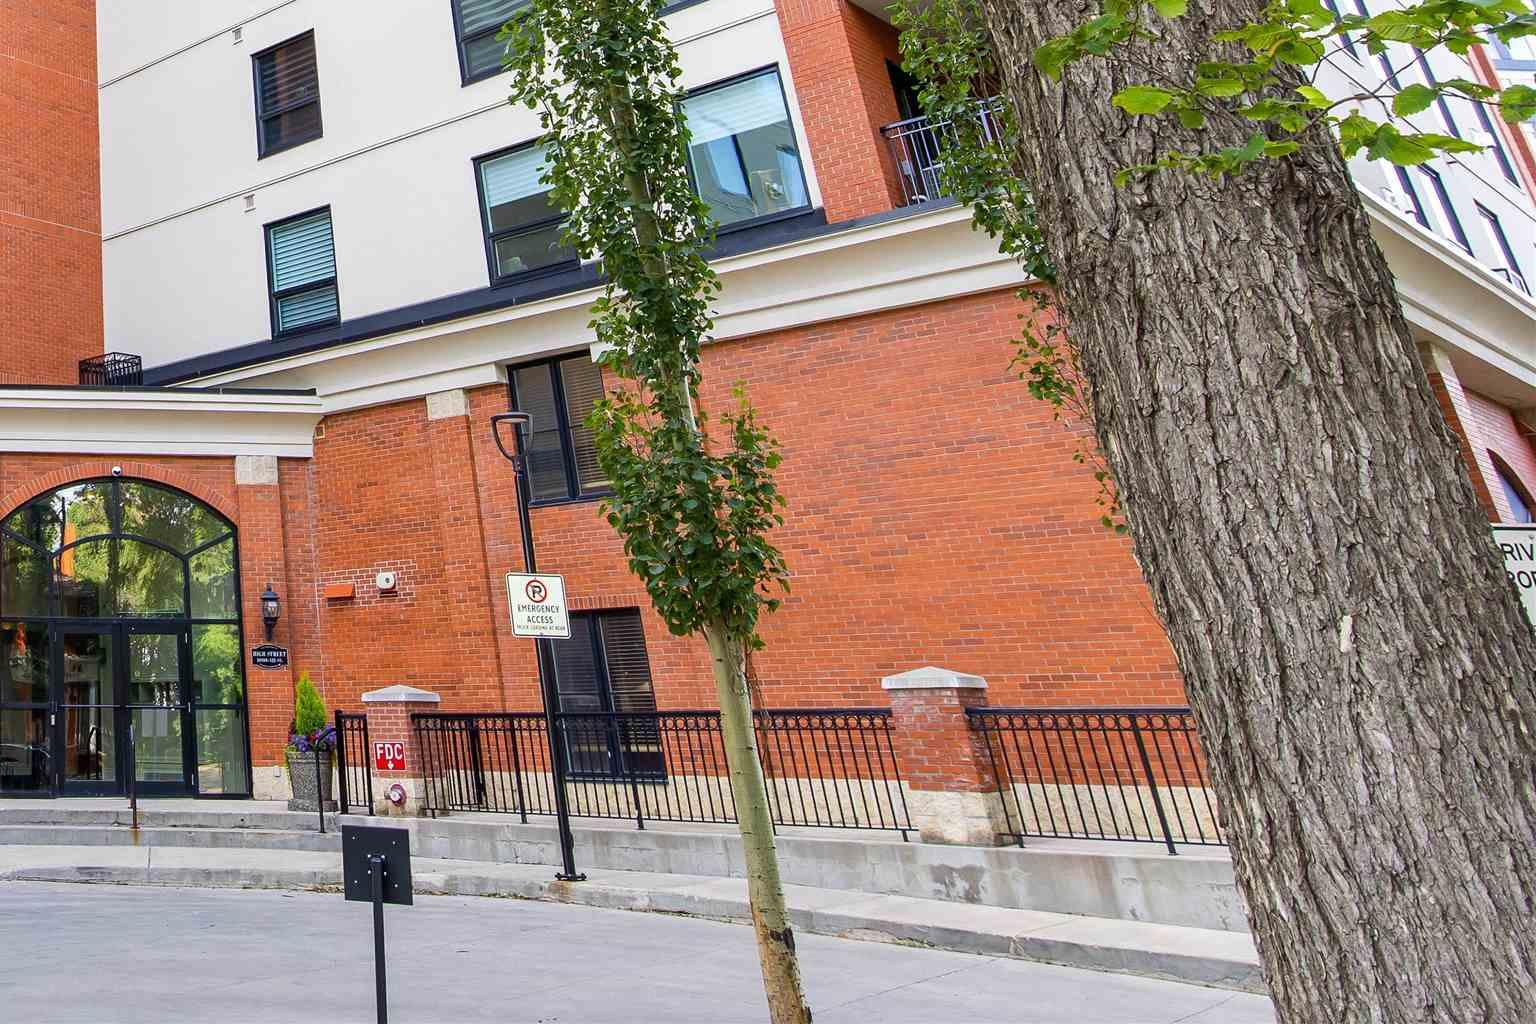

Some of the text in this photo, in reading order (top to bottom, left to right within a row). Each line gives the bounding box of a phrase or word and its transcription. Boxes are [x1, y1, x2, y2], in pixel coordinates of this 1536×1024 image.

[1499, 543, 1534, 561] RIV
[517, 604, 560, 614] EMERGENCY
[527, 615, 554, 624] ACCESS
[375, 743, 403, 760] FDC
